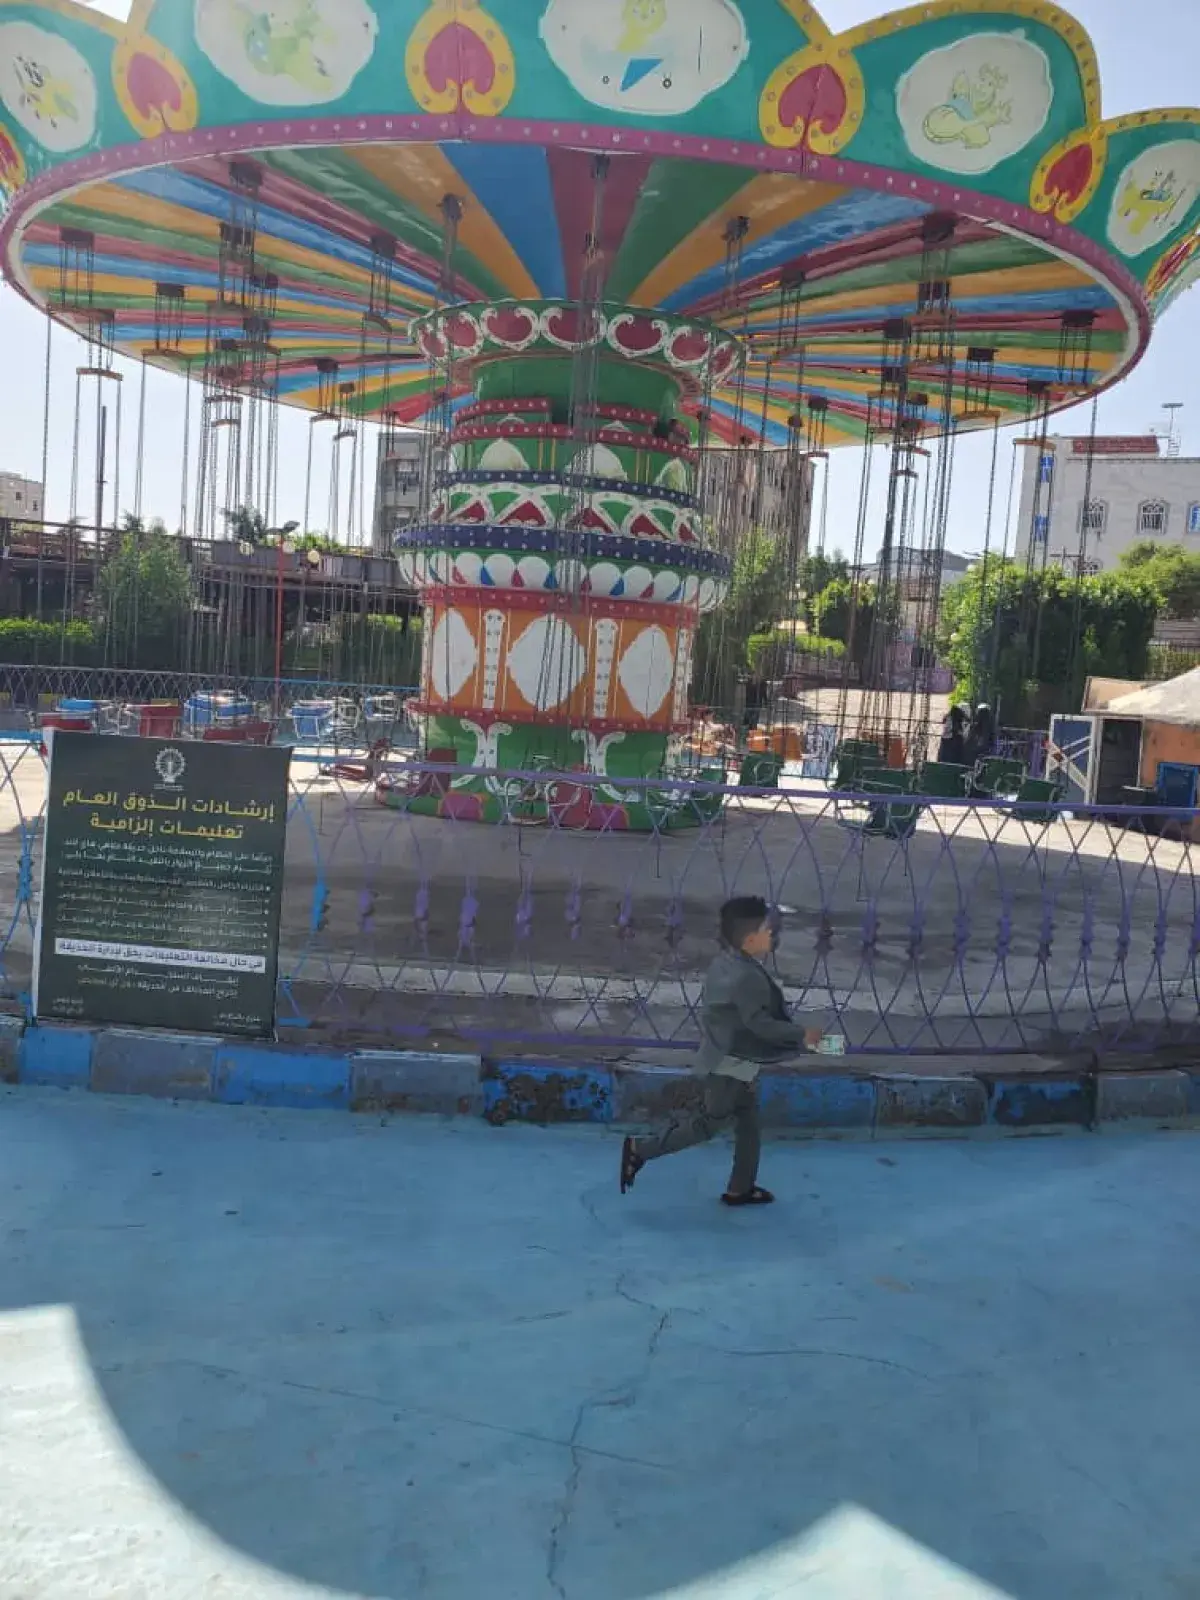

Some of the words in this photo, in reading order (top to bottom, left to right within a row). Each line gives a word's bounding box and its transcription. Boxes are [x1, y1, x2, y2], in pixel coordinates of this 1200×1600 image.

[62, 788, 118, 807] العام
[122, 791, 187, 813] الذوق
[191, 799, 275, 823] إرشادات
[89, 812, 154, 838] إلزامية
[159, 819, 244, 842] تعليمات
